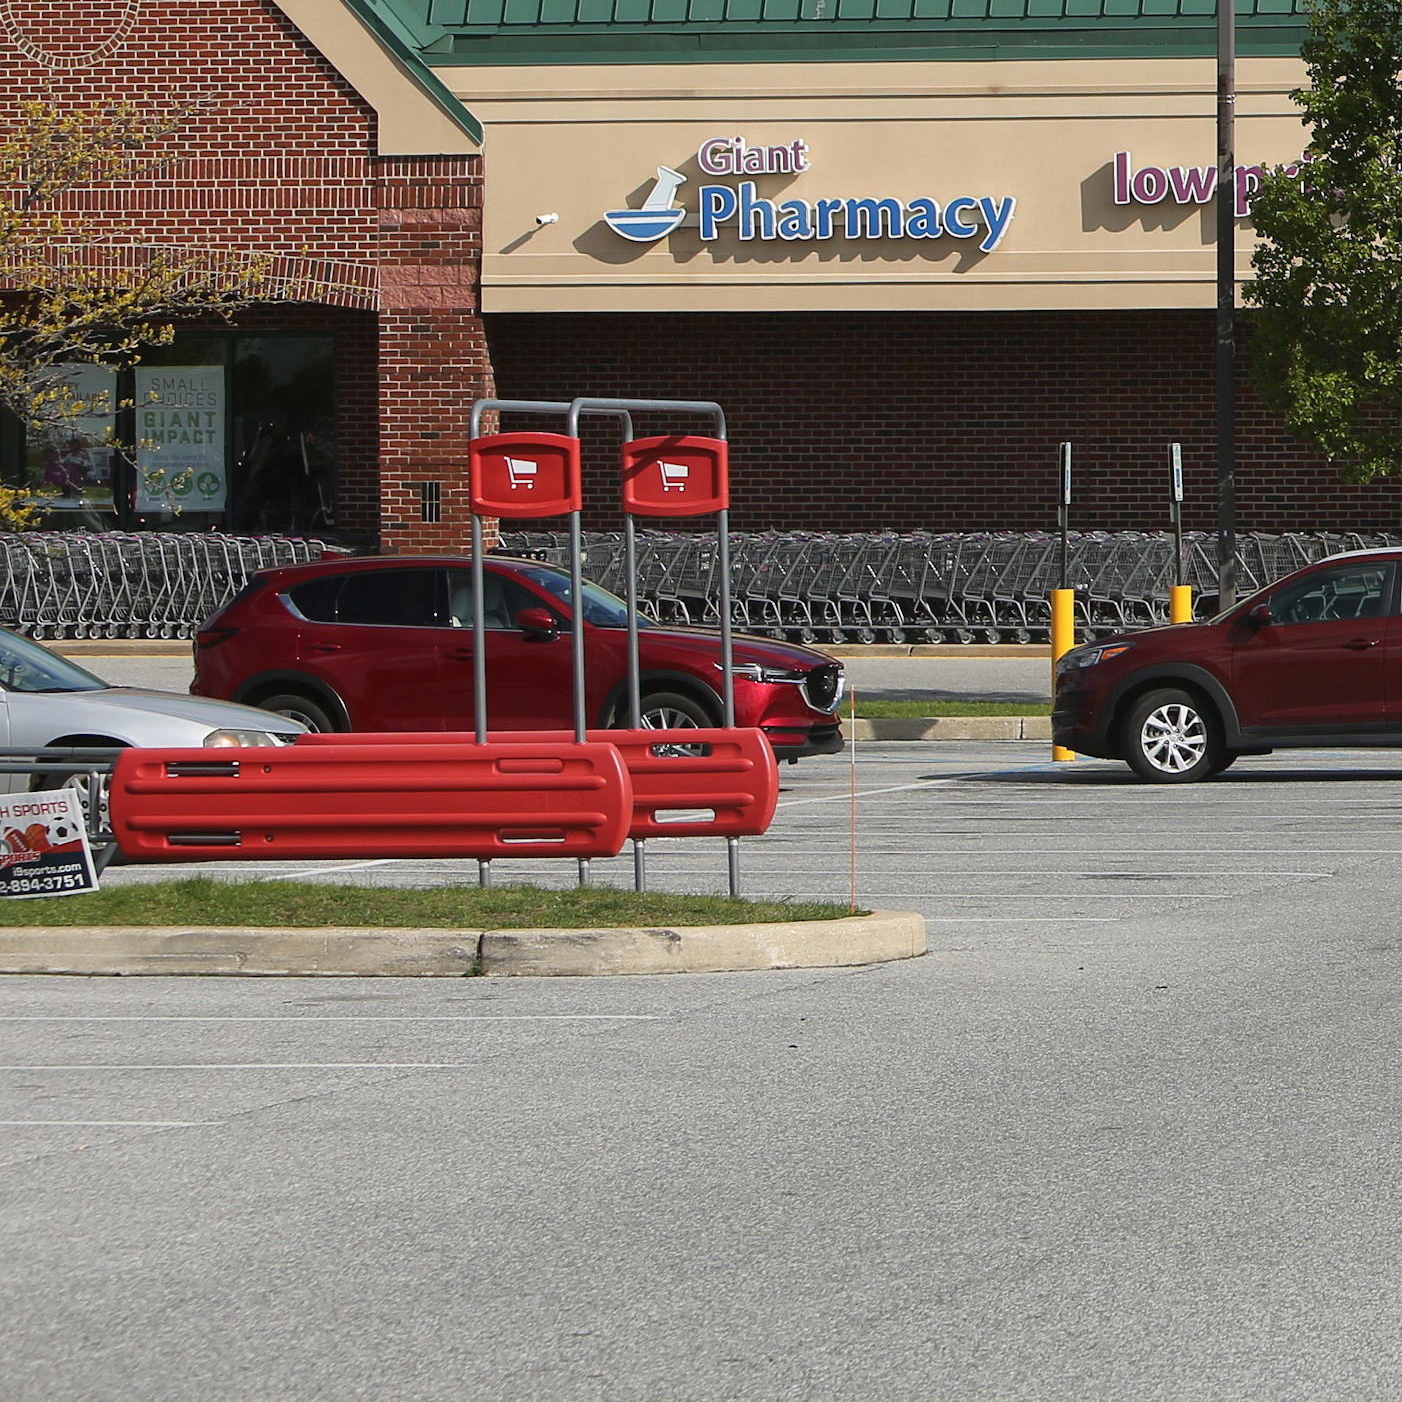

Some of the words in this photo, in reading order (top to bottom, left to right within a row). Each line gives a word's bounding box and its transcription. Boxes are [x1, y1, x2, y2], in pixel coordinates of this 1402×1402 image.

[697, 135, 812, 175] Giant
[1113, 150, 1217, 204] low
[699, 181, 1016, 253] Pharmacy
[151, 378, 209, 391] SMALL
[144, 392, 217, 406] CHOICES
[144, 411, 217, 428] GIANT
[144, 429, 216, 444] IMPACT
[13, 801, 68, 817] SPORTS
[13, 863, 82, 878] i9sports.com
[0, 874, 84, 893] 2-894-3751
